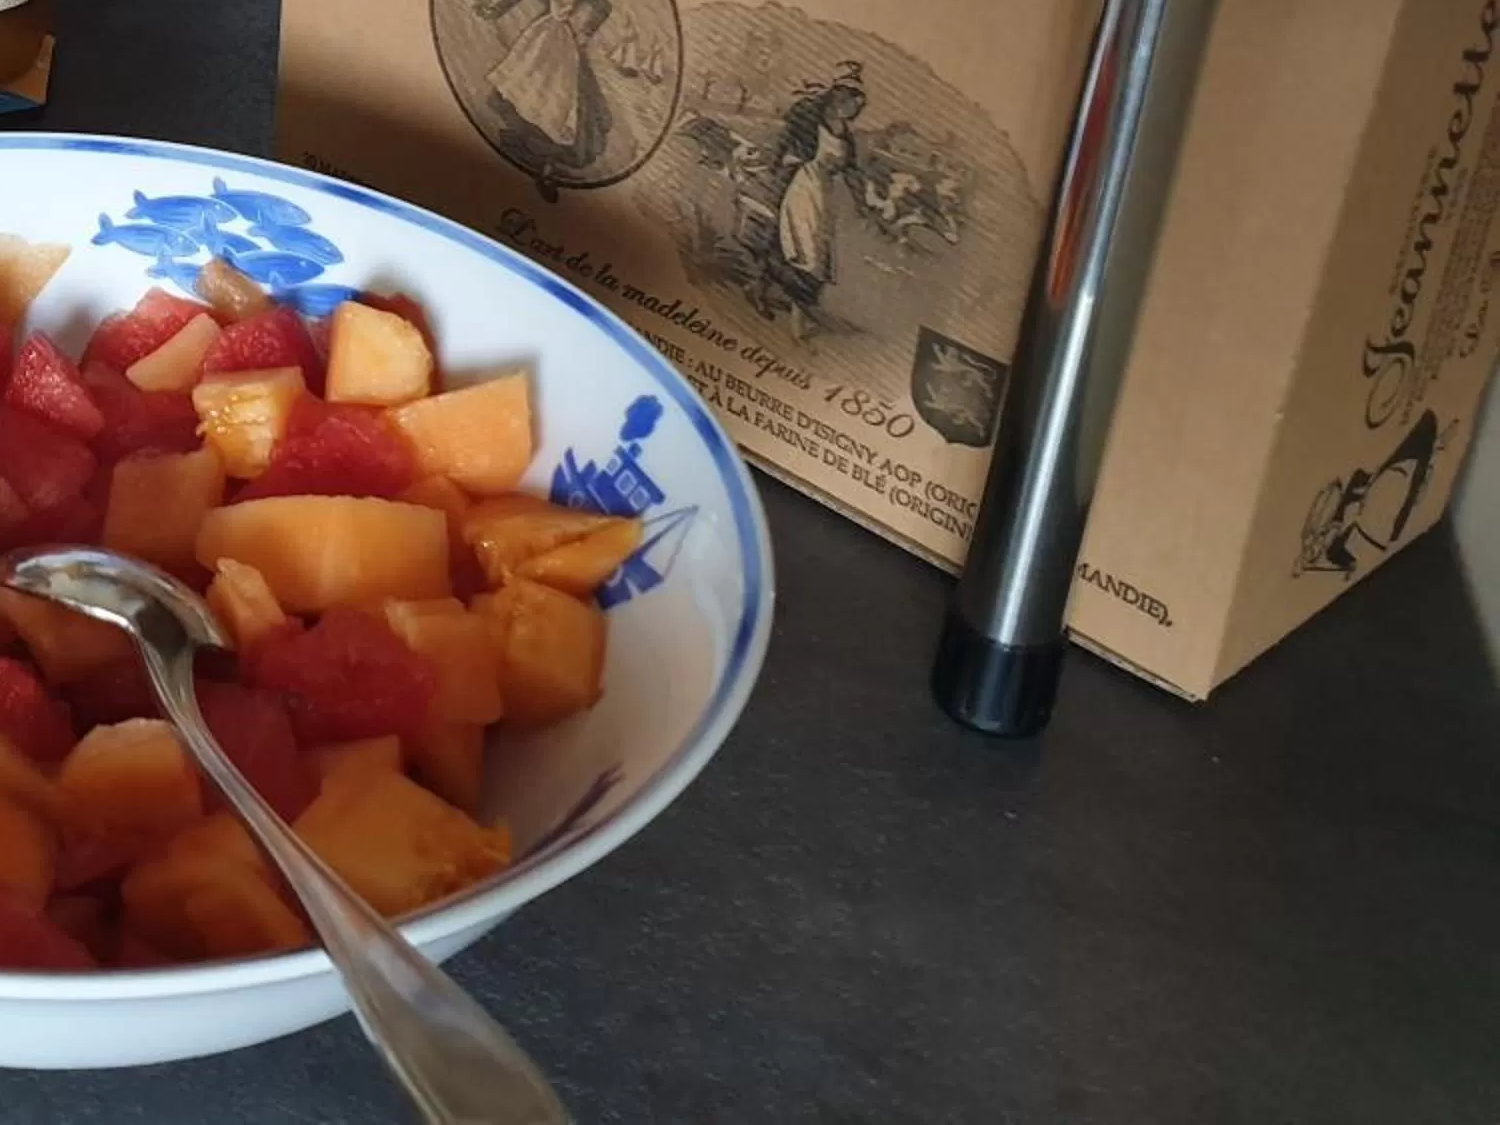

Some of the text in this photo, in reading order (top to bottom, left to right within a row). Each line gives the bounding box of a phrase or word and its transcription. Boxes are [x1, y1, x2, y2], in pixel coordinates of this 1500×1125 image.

[565, 251, 595, 277] de
[594, 262, 621, 293] la
[621, 282, 739, 353] madeleine
[739, 341, 812, 392] depuis
[823, 384, 916, 440] 1850
[694, 359, 722, 383] AU
[724, 371, 794, 422] BEURRE
[796, 410, 879, 466] D'ISIGNY
[879, 456, 922, 488] AOP
[726, 395, 751, 424] LA
[753, 414, 819, 459] FARINE
[822, 447, 849, 476] DE
[850, 467, 887, 495] BLÉ
